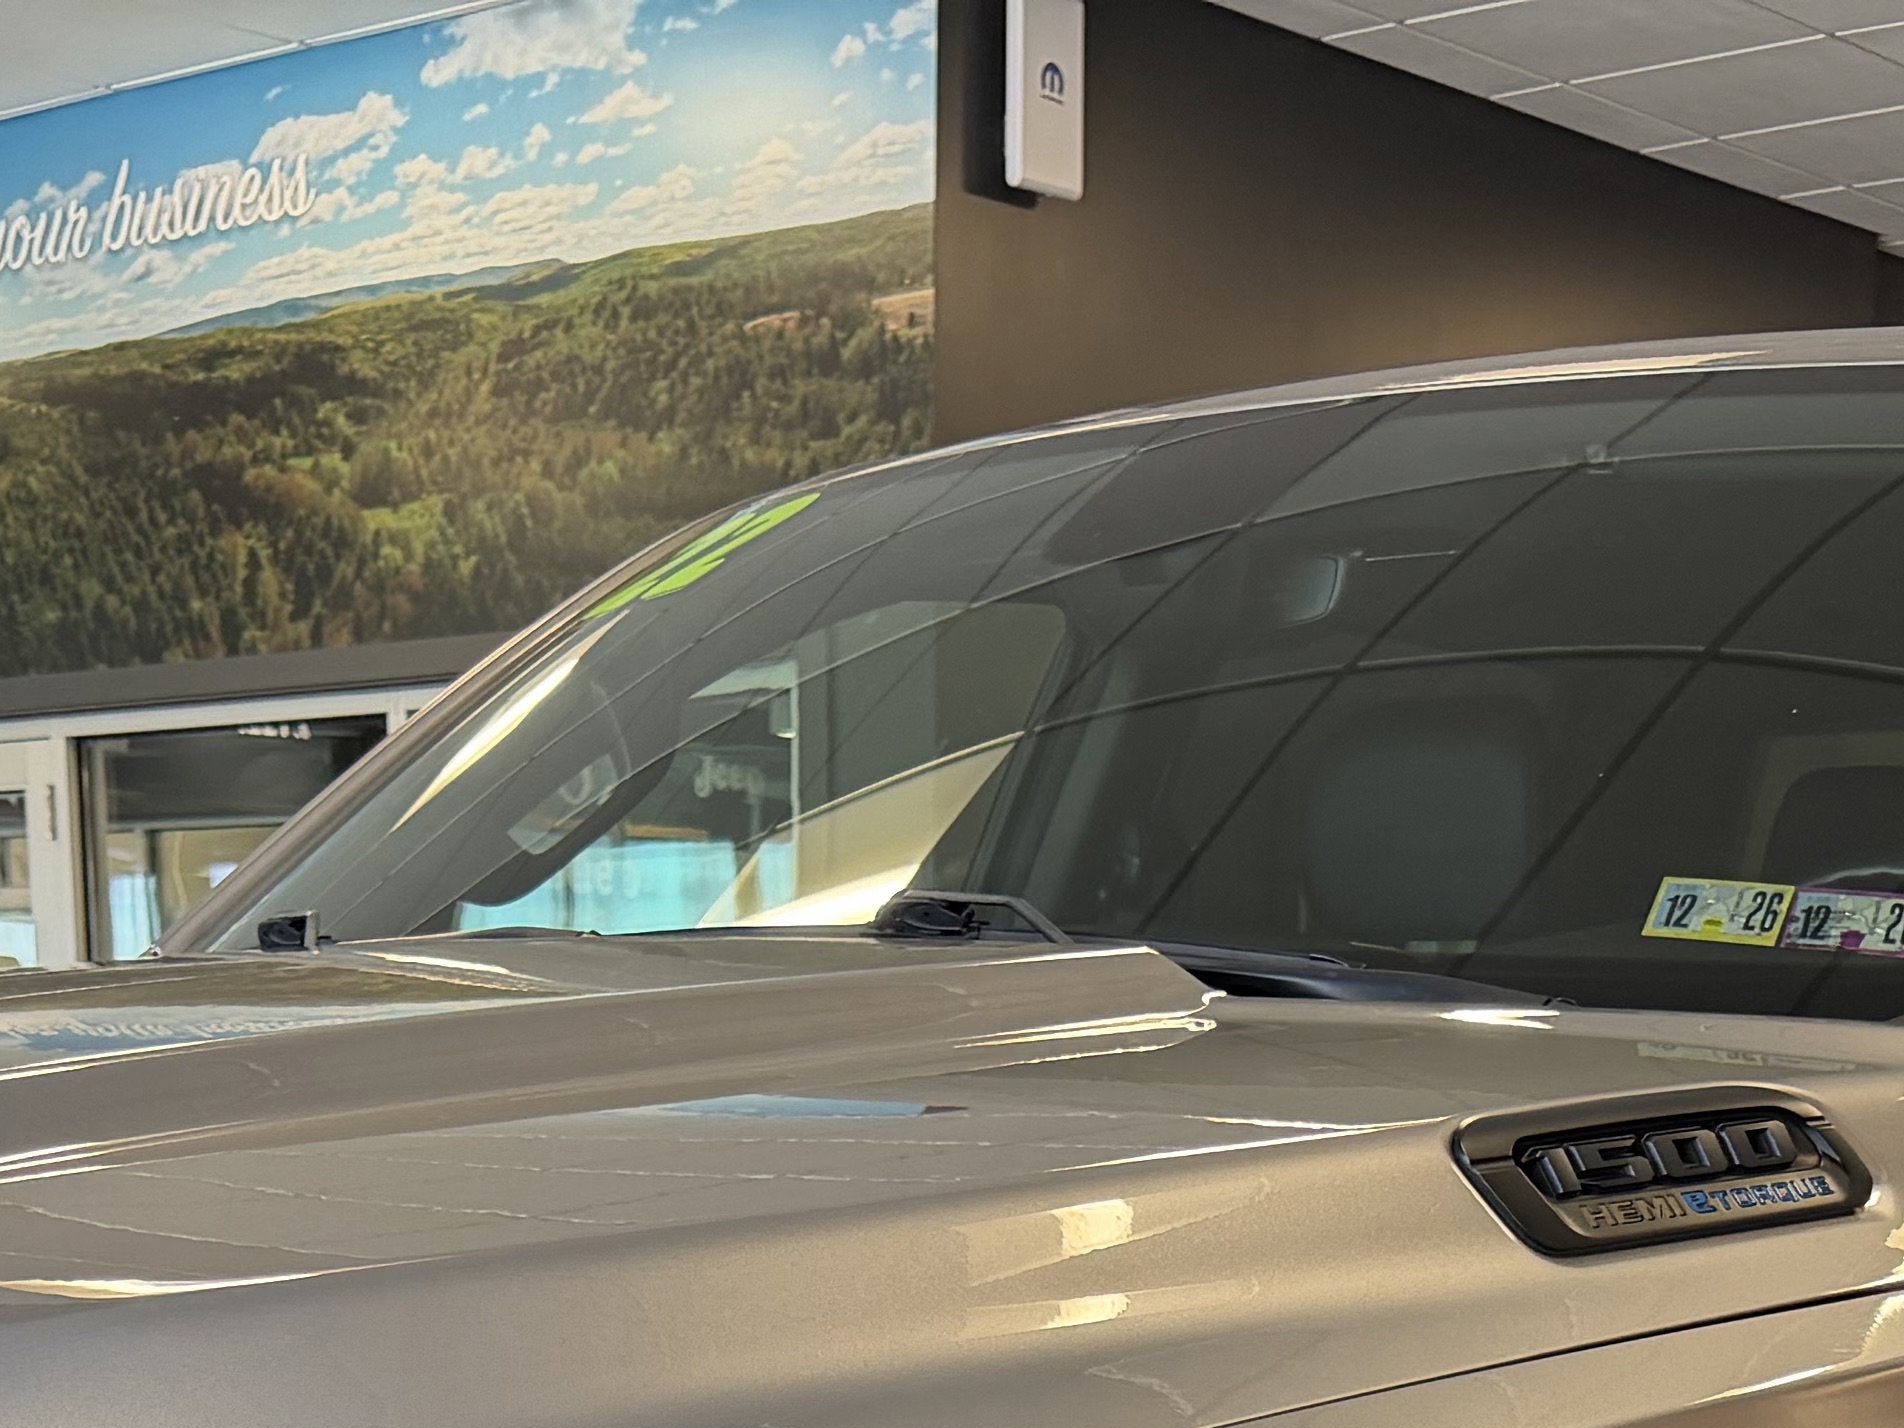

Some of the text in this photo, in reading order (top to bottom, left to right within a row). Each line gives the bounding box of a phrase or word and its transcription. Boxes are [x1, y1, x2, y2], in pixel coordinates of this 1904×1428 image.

[101, 157, 318, 251] business
[1663, 891, 1784, 933] 12 26
[1799, 905, 1831, 940] 12
[1521, 1119, 1799, 1199] 1500
[1580, 1193, 1687, 1229] HEMI
